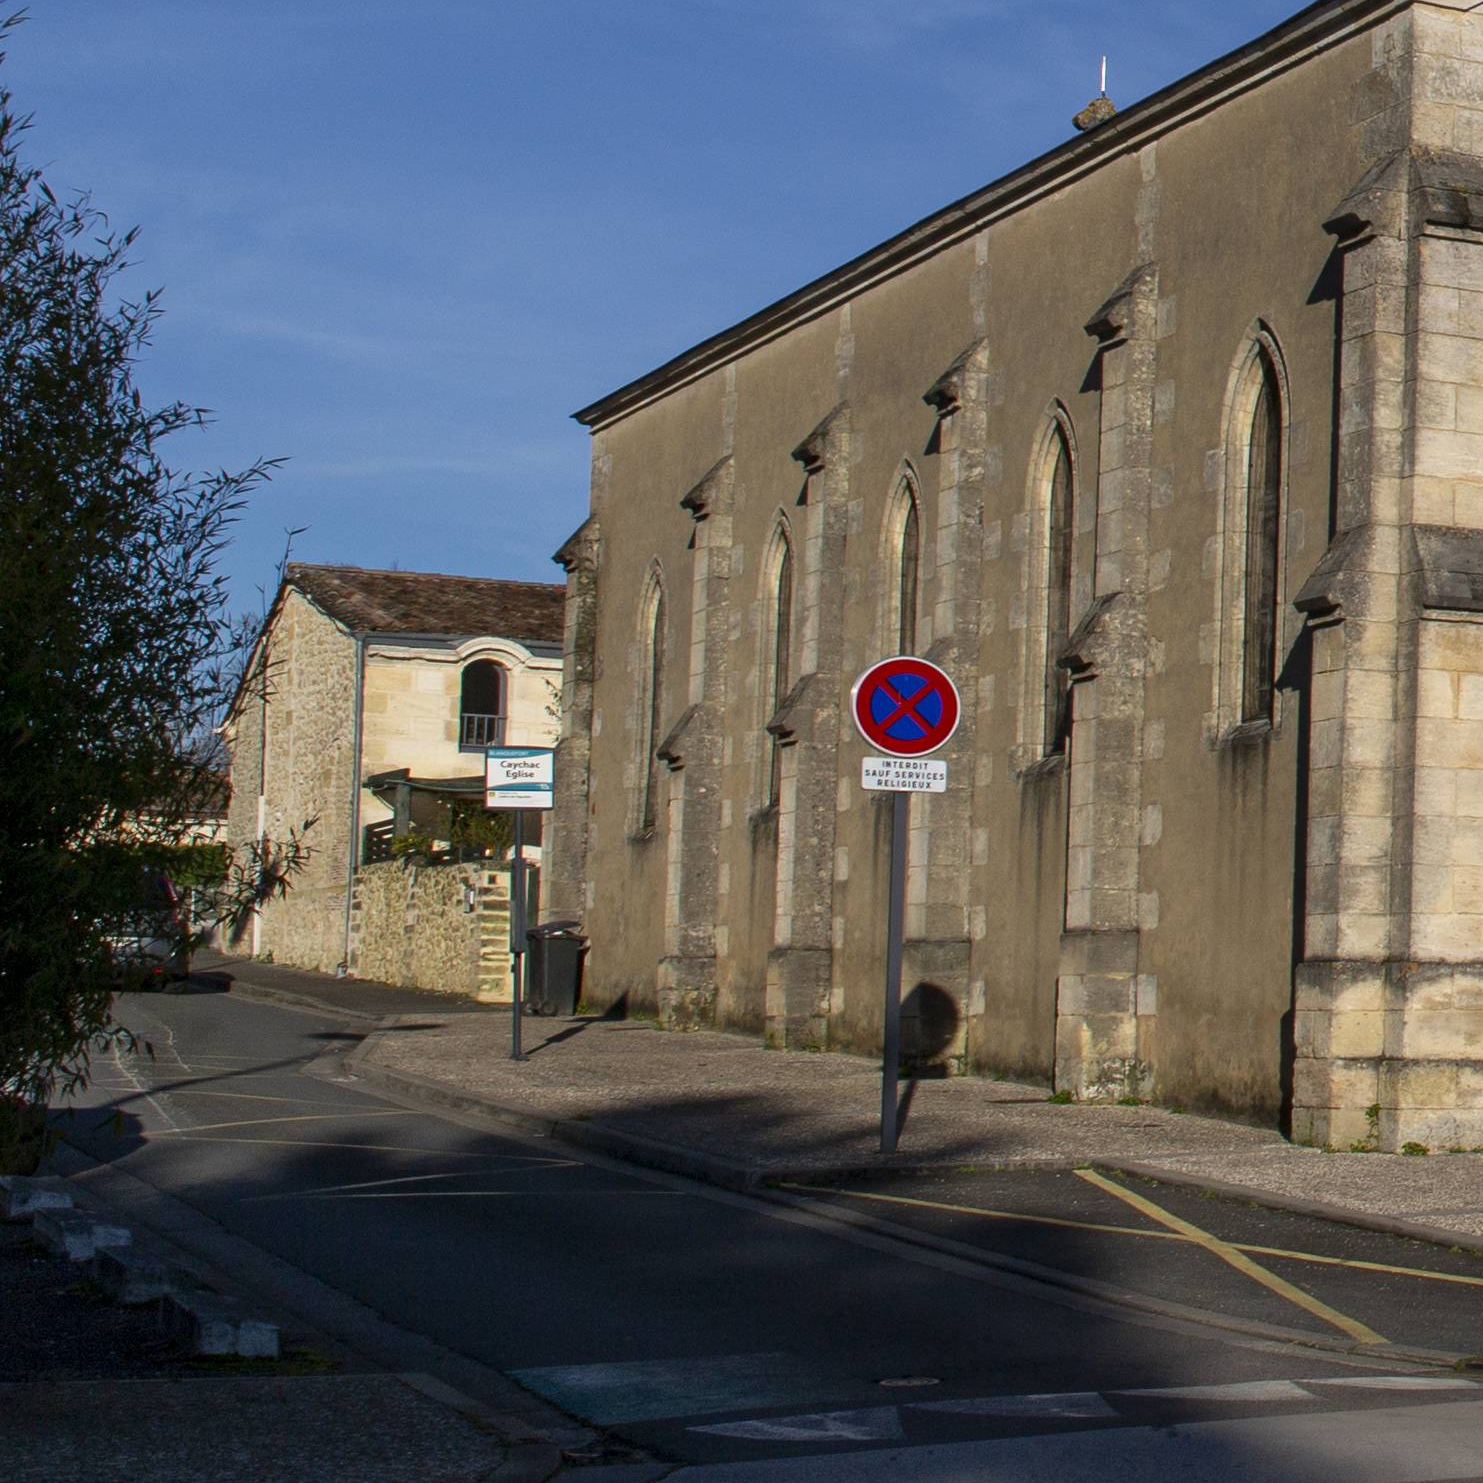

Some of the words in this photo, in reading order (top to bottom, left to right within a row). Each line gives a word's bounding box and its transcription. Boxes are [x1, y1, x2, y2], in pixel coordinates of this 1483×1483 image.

[500, 760, 541, 769] Caychac
[882, 761, 929, 770] INTERDIT
[506, 770, 535, 779] Eglise
[865, 769, 891, 778] SAUF
[894, 771, 945, 781] SERVICES
[877, 779, 932, 789] RELIGIEUX
